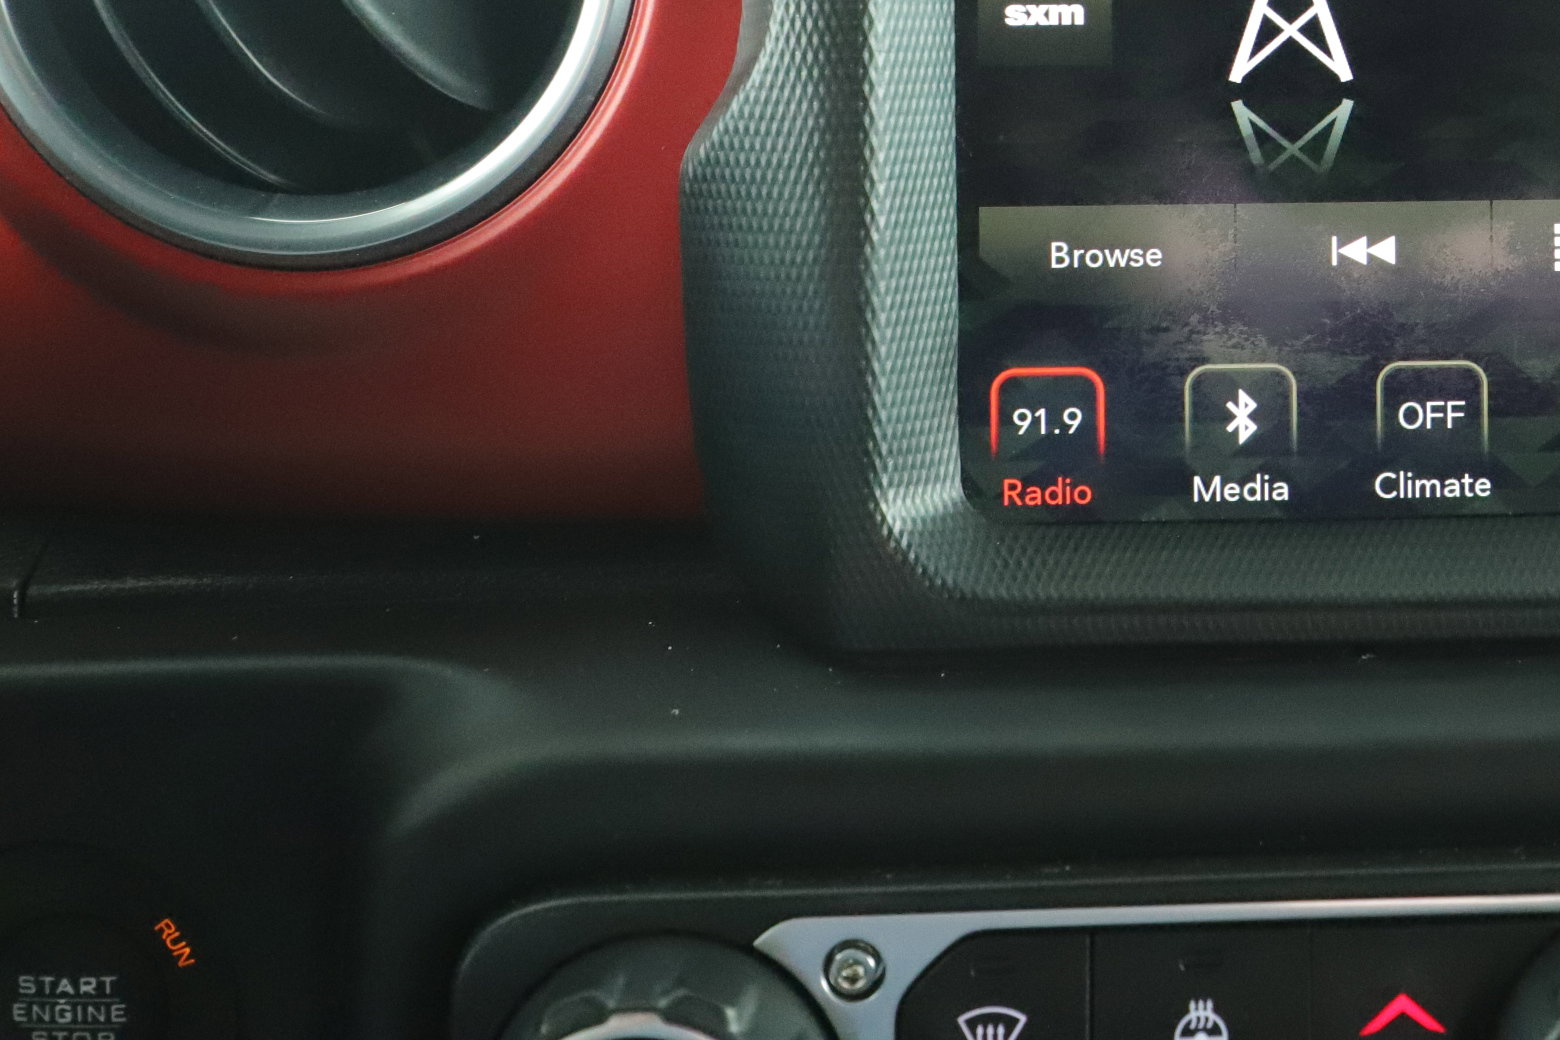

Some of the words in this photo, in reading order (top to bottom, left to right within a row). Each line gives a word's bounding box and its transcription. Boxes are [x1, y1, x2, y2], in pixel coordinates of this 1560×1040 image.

[1004, 3, 1086, 27] sxm
[1049, 241, 1164, 269] Browse
[1011, 407, 1084, 436] 91.9
[1397, 400, 1467, 430] OFF
[1002, 476, 1094, 508] Radio
[1192, 473, 1290, 503] Media
[1373, 470, 1493, 500] Climate
[154, 917, 196, 968] RUN
[18, 975, 118, 995] START
[12, 1002, 127, 1023] ENGINE
